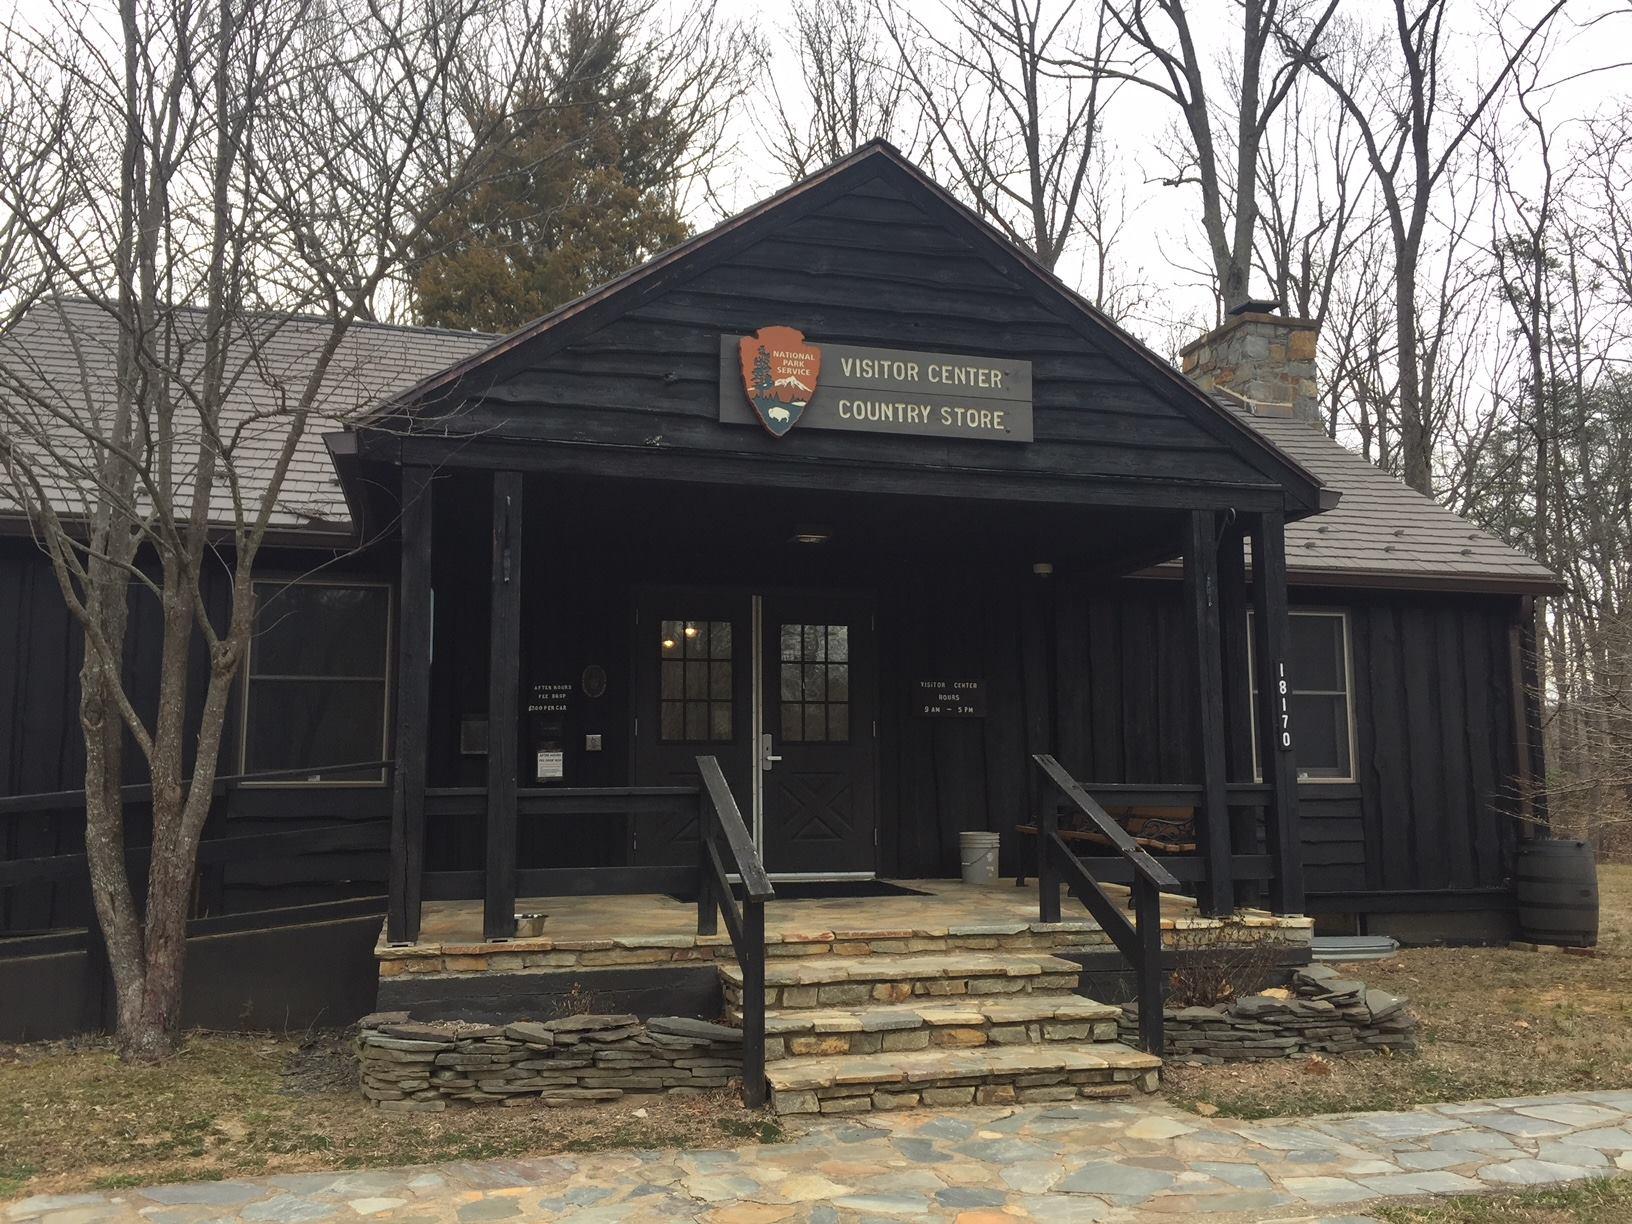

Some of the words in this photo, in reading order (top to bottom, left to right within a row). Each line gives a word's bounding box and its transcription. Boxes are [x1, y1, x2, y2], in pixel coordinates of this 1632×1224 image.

[772, 350, 816, 361] NATIONAL
[782, 359, 805, 368] PARK
[776, 366, 811, 376] SERVICE
[840, 357, 919, 382] VISITOR
[927, 364, 1002, 389] CENTER
[838, 399, 931, 424] COUNTRY
[940, 406, 1005, 430] STORE
[1278, 662, 1291, 747] 18170
